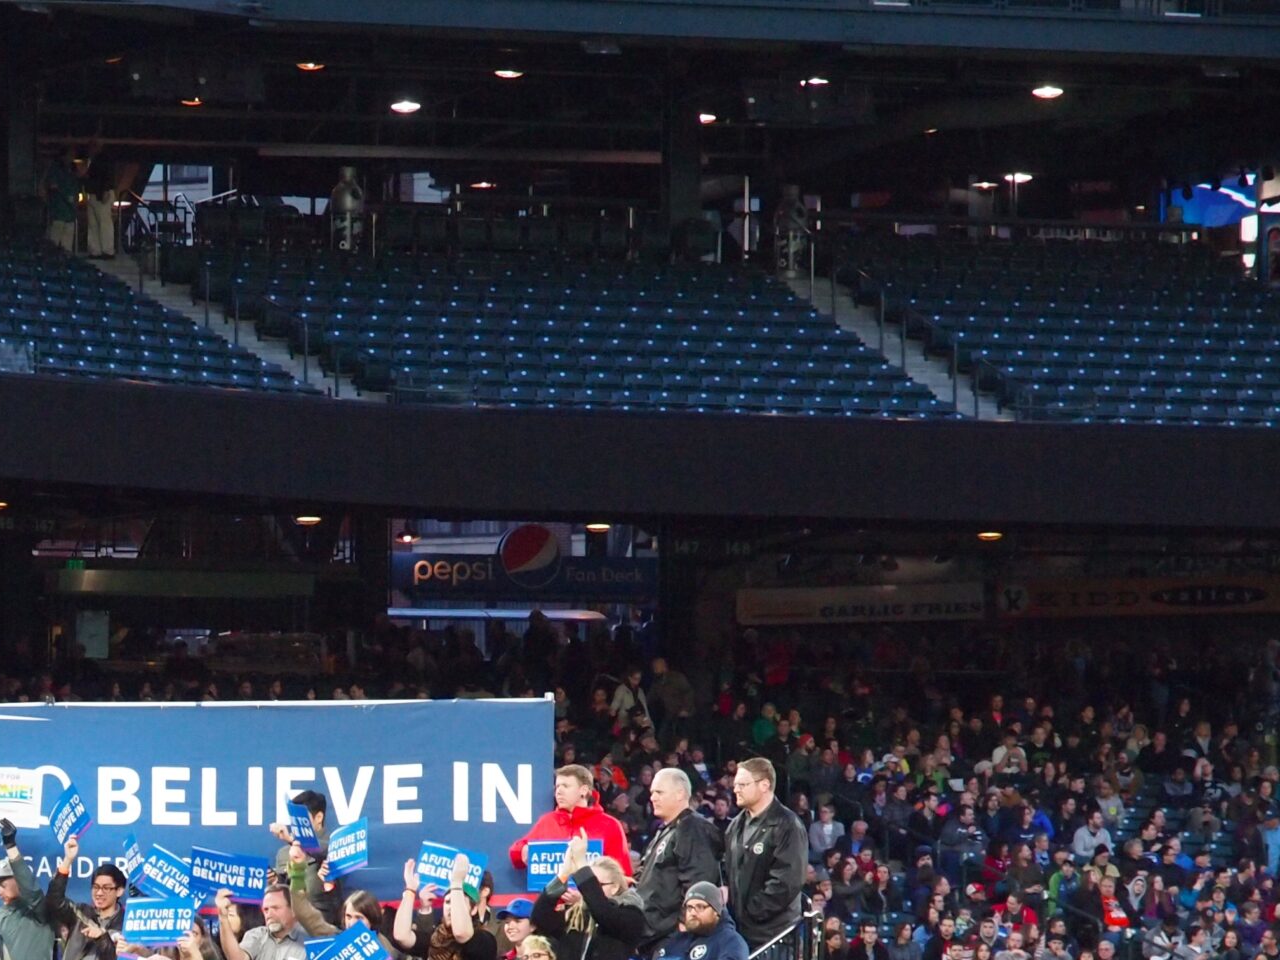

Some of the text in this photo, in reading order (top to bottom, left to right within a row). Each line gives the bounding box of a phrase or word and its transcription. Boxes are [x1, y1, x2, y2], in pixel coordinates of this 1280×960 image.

[413, 557, 643, 586] pepsi Fan Deck
[821, 604, 904, 618] GARLIC
[911, 603, 982, 616] FRIES
[70, 794, 80, 807] TO
[97, 764, 423, 826] BELIEVE
[453, 762, 533, 824] IN
[76, 802, 85, 816] IN
[299, 817, 310, 827] TO
[302, 827, 314, 838] IN
[357, 830, 366, 839] TO
[357, 839, 366, 850] IN
[421, 852, 429, 862] A
[429, 854, 454, 870] FUTU
[531, 852, 539, 862] A
[148, 855, 156, 866] A
[157, 859, 190, 888] FUTUR
[194, 857, 264, 878] A FUTURE TO
[143, 863, 190, 898] BELIEVE
[192, 866, 263, 889] BELIEVE IN
[127, 908, 192, 919] A FUTURE TO
[125, 919, 191, 931] BELIEVE IN
[354, 932, 371, 946] TO
[362, 940, 379, 957] IN
